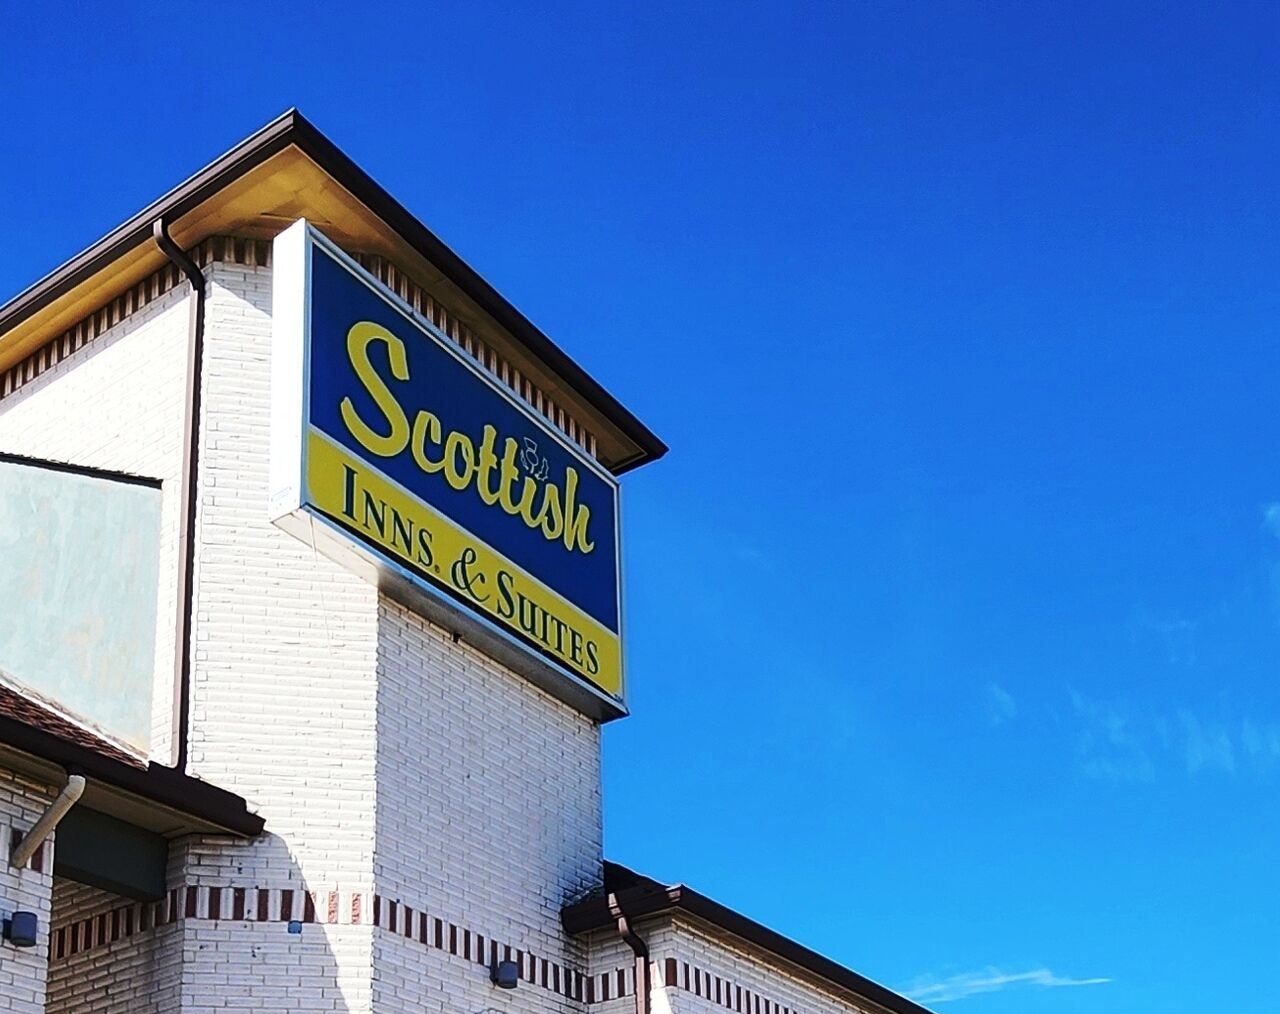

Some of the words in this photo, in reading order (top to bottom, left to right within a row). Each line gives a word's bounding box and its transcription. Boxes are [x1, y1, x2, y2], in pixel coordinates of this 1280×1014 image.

[339, 320, 596, 555] Scottish
[451, 547, 491, 603] &
[496, 570, 600, 675] SUITES
